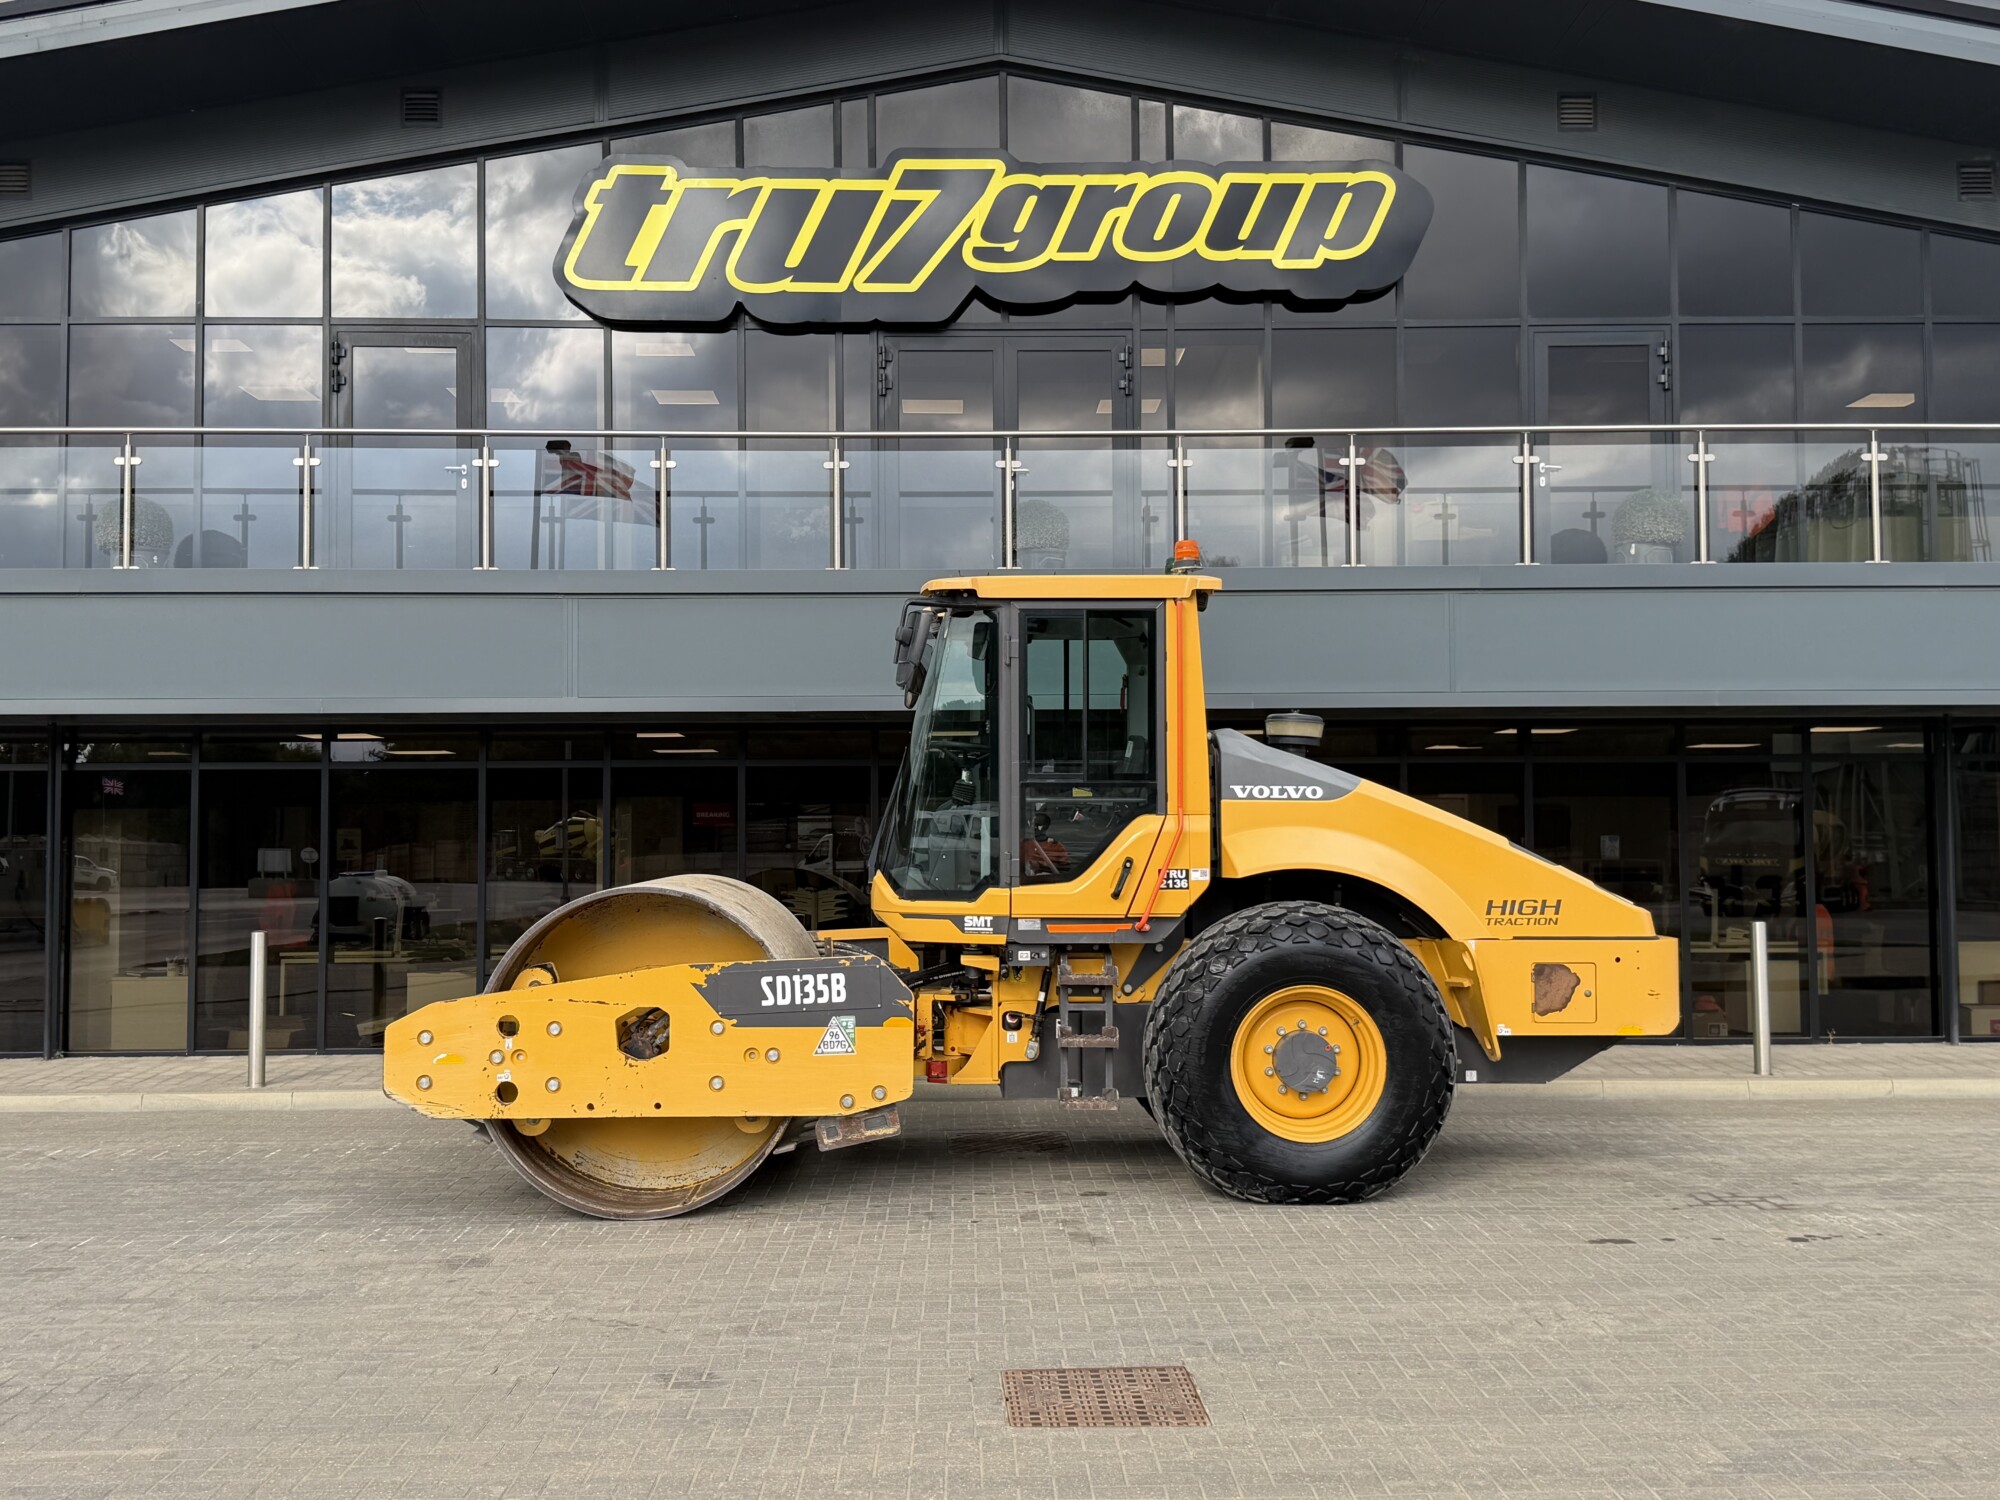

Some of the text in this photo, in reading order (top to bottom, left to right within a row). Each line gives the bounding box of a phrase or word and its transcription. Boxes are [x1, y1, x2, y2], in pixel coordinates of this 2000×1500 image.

[1229, 785, 1323, 799] VOLVO
[1160, 879, 1189, 888] 2136
[1485, 899, 1562, 916] HIGH
[964, 916, 993, 927] SMT
[1485, 917, 1559, 926] TRACTION
[760, 972, 847, 1006] SD135B
[828, 1030, 840, 1040] 96
